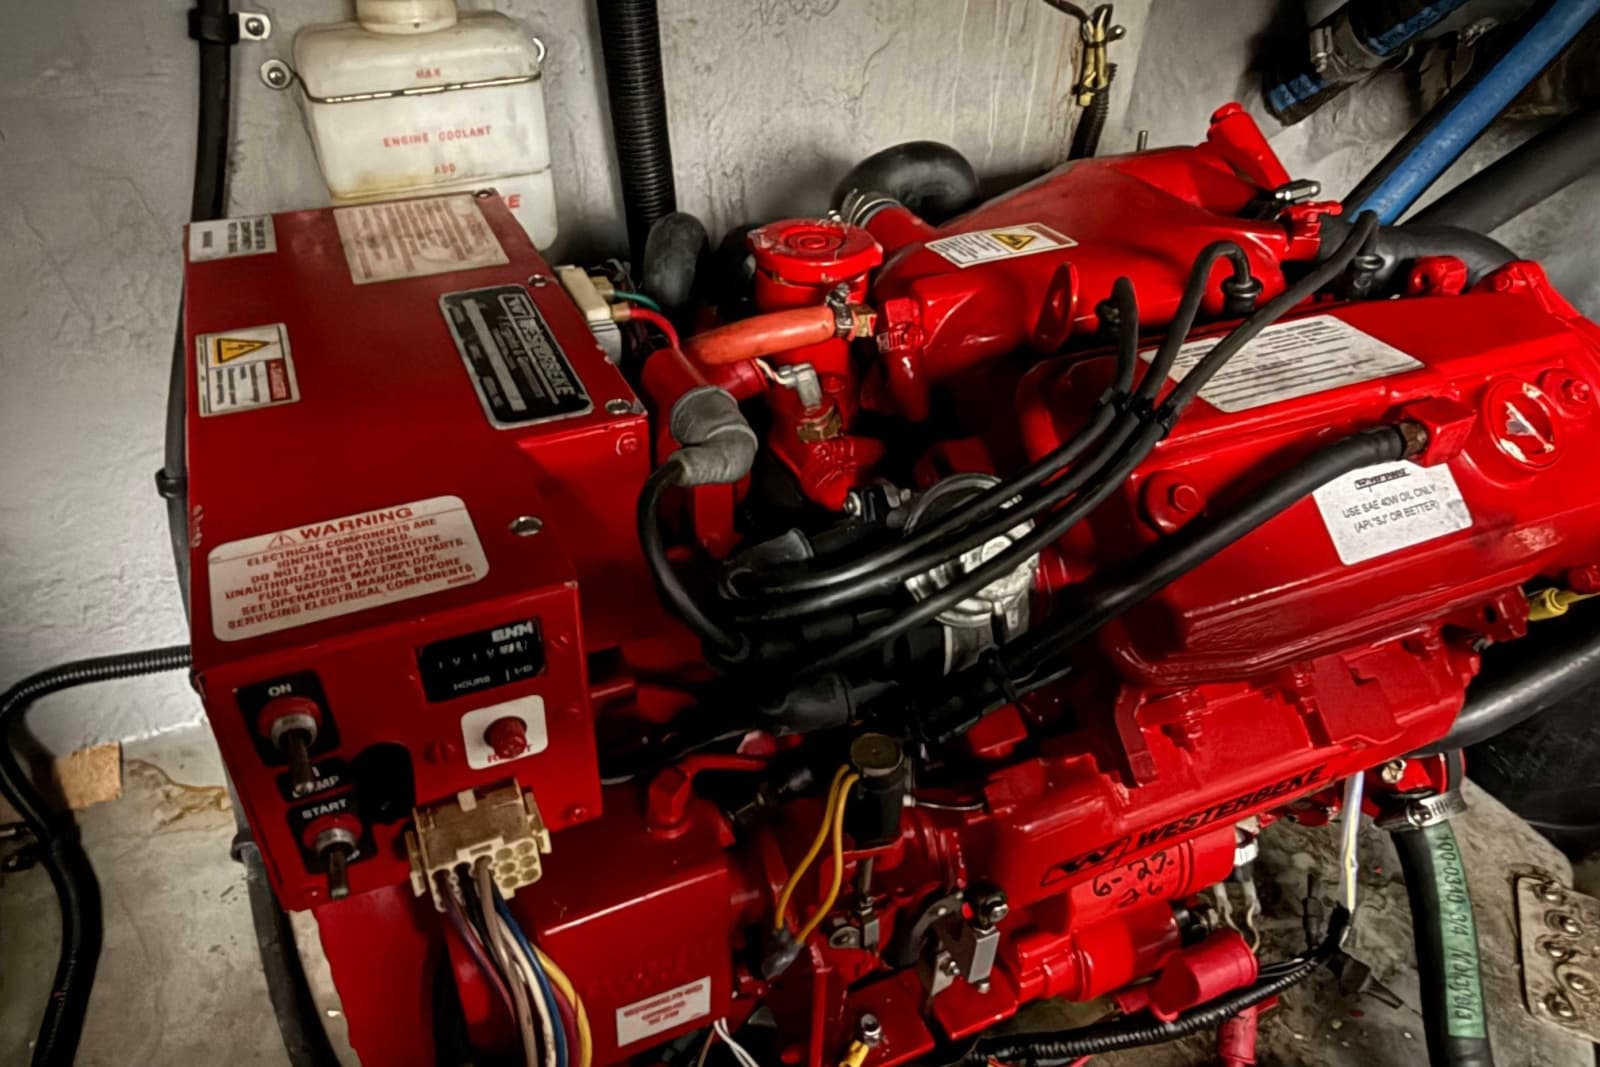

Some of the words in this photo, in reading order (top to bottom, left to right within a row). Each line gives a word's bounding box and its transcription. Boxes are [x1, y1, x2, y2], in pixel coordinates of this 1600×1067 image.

[415, 68, 441, 79] MAX
[383, 132, 429, 148] ENGINE
[438, 125, 492, 142] COOLANT
[433, 163, 457, 175] ADD
[1341, 504, 1362, 519] USE
[1361, 500, 1381, 514] SAE
[1399, 490, 1414, 503] OIL
[1413, 483, 1436, 498] ONLY
[1387, 510, 1404, 522] OR
[1403, 499, 1441, 518] BETTER)
[299, 507, 413, 539] WARNING
[247, 543, 321, 567] ELECTRICAL
[326, 523, 410, 549] COMPONENTS
[413, 518, 436, 530] ARE
[225, 569, 327, 600] UNAUTHORIZED
[331, 547, 421, 575] REPLACEMENT
[251, 572, 270, 584] DO
[273, 566, 299, 578] NOT
[304, 556, 342, 572] ALTER
[345, 551, 364, 563] OR
[367, 534, 441, 558] SUBSTITUTE
[277, 549, 333, 569] IGNITION
[227, 605, 301, 630] SERVICING
[304, 586, 382, 611] ELECTRICAL
[386, 563, 473, 592] COMPONENTS
[241, 603, 266, 616] SEE
[271, 582, 353, 610] OPERATOR'S
[356, 569, 410, 589] MANUAL
[413, 557, 461, 575] BEFORE
[258, 587, 291, 601] FUEL
[294, 574, 347, 593] VAPORS
[350, 565, 377, 580] MAY
[491, 620, 534, 643] ENM
[267, 683, 293, 697] ON
[301, 798, 348, 819] START
[1136, 763, 1328, 849] WESTERBEKE
